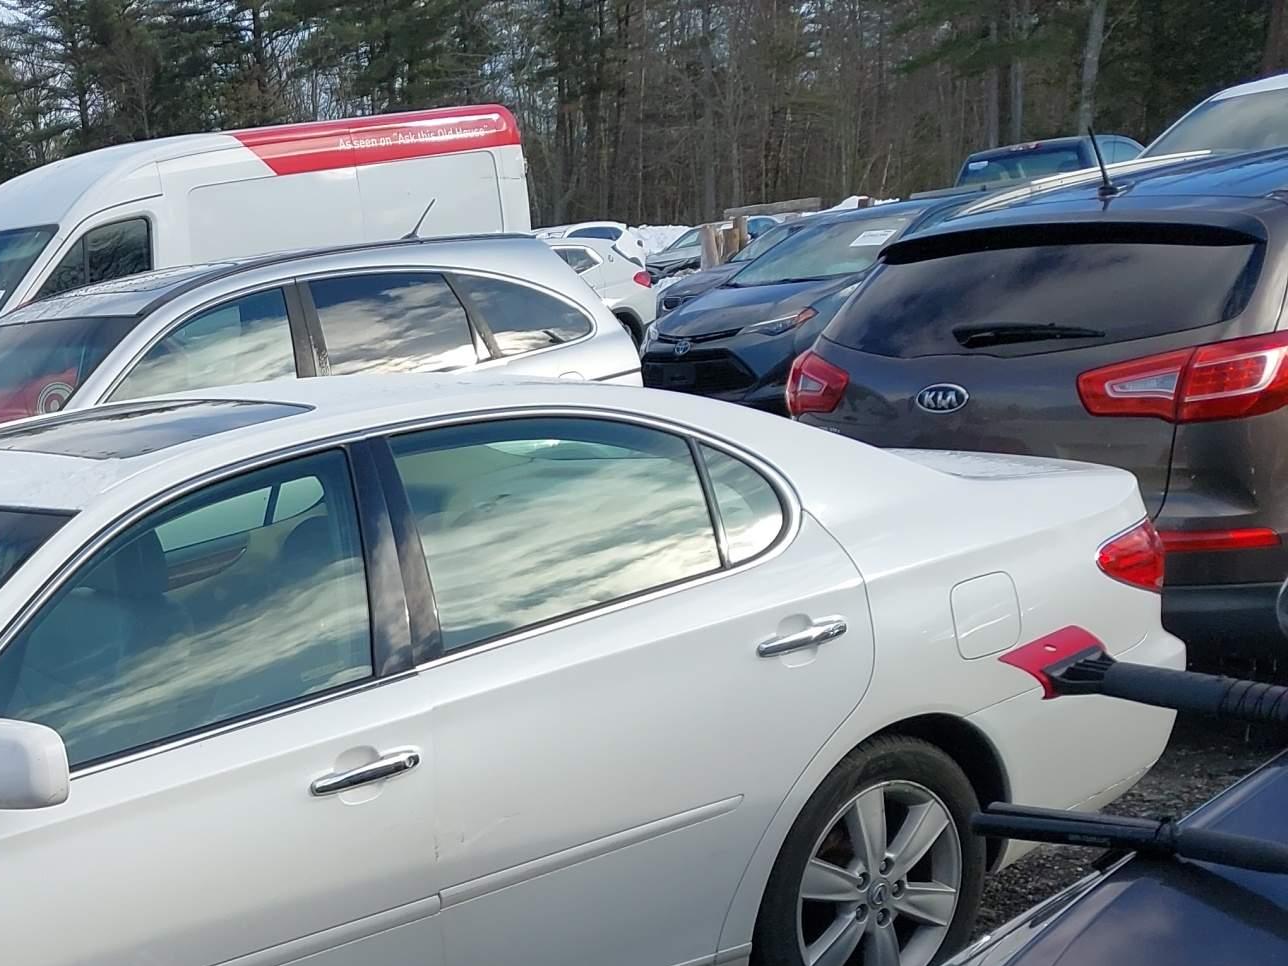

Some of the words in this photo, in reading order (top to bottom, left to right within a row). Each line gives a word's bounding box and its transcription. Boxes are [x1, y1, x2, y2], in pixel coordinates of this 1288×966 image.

[338, 138, 352, 149] As
[353, 137, 377, 148] seen
[379, 136, 392, 147] on
[436, 129, 452, 140] Old
[923, 391, 958, 408] KIA
